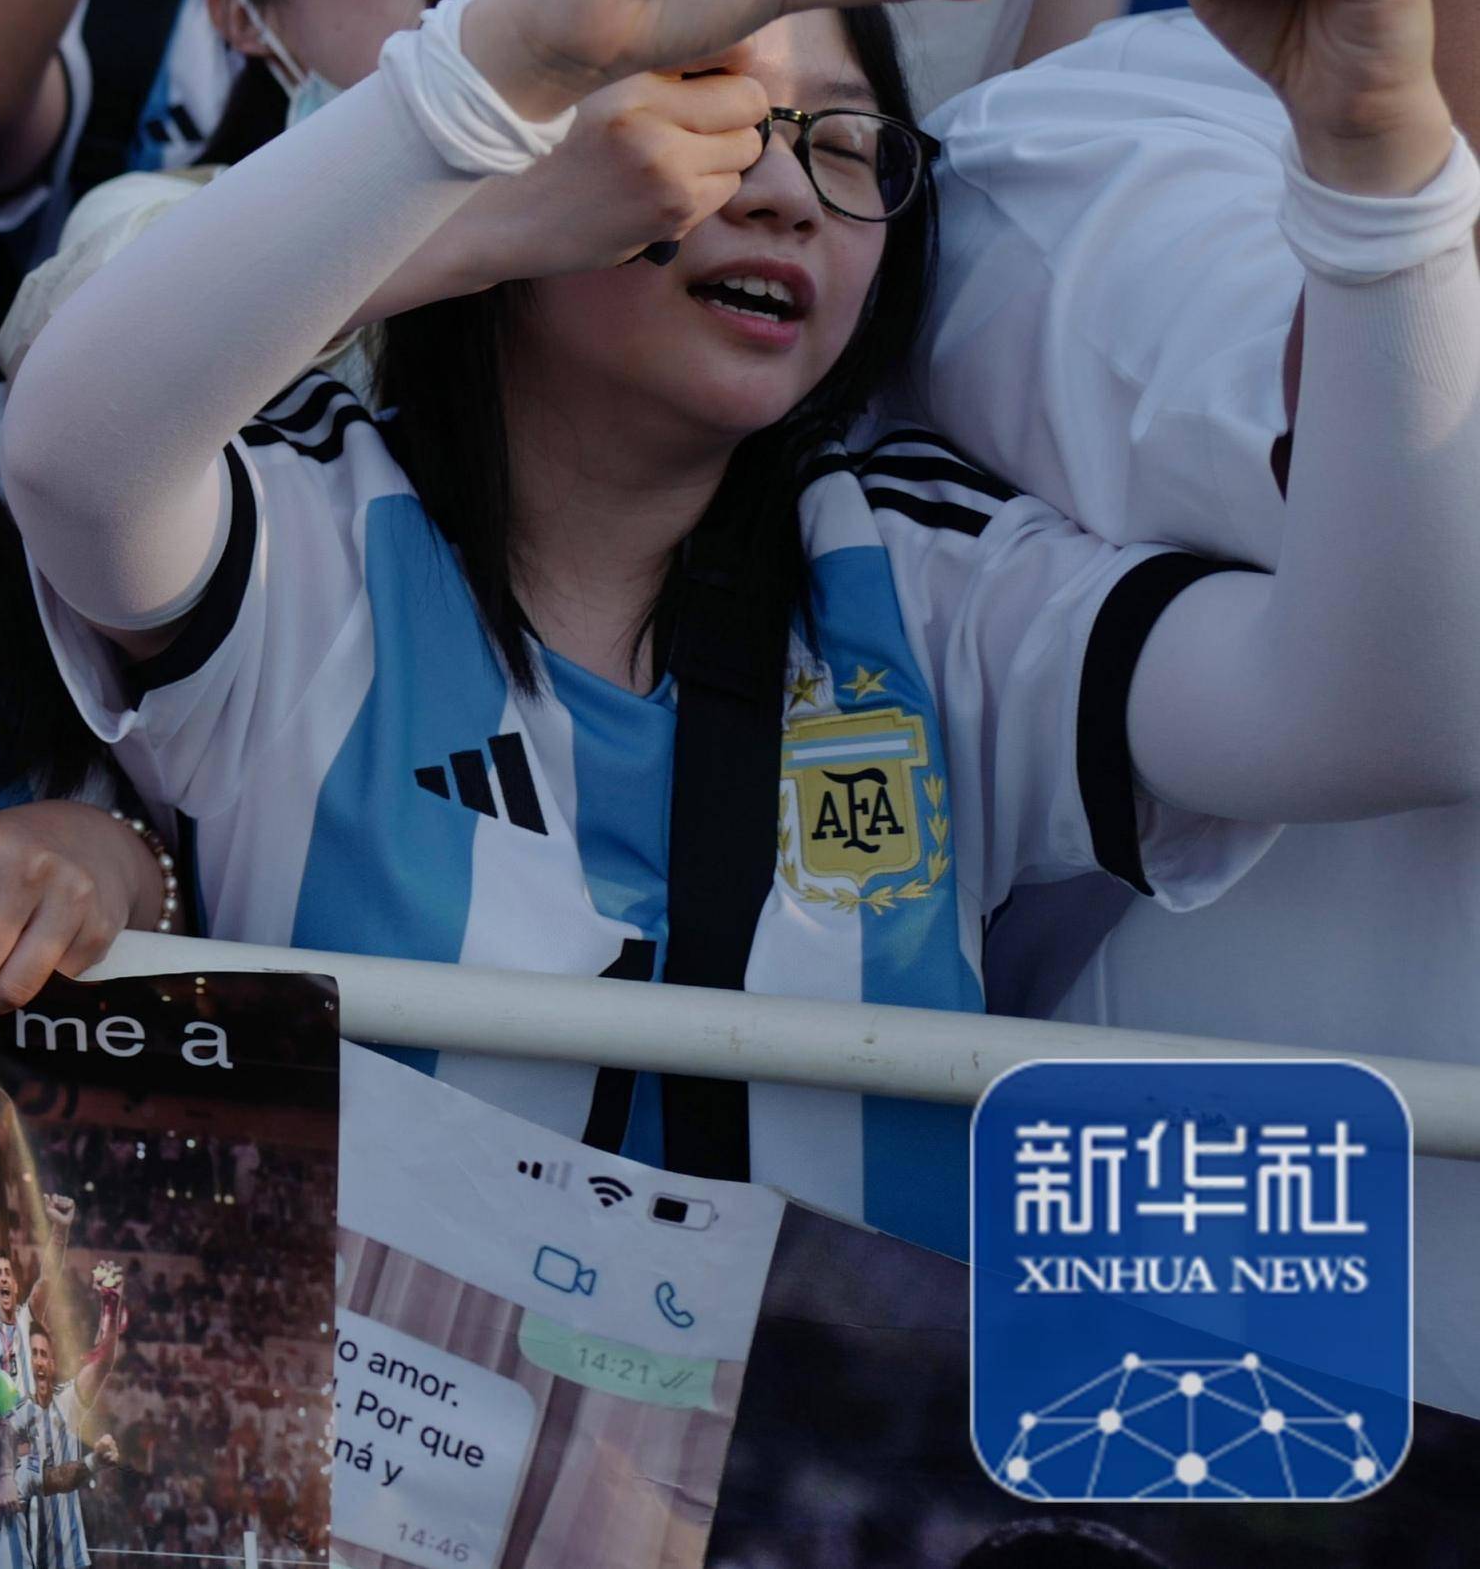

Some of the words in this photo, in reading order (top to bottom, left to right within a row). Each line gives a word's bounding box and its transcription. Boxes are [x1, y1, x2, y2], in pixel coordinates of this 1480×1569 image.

[811, 767, 905, 854] AFA
[181, 1019, 234, 1071] a
[368, 1349, 460, 1408] amor.
[577, 1345, 652, 1388] 14:21
[355, 1390, 414, 1437] Por
[420, 1424, 486, 1471] que
[380, 1456, 406, 1489] y
[397, 1520, 470, 1565] 14:46
